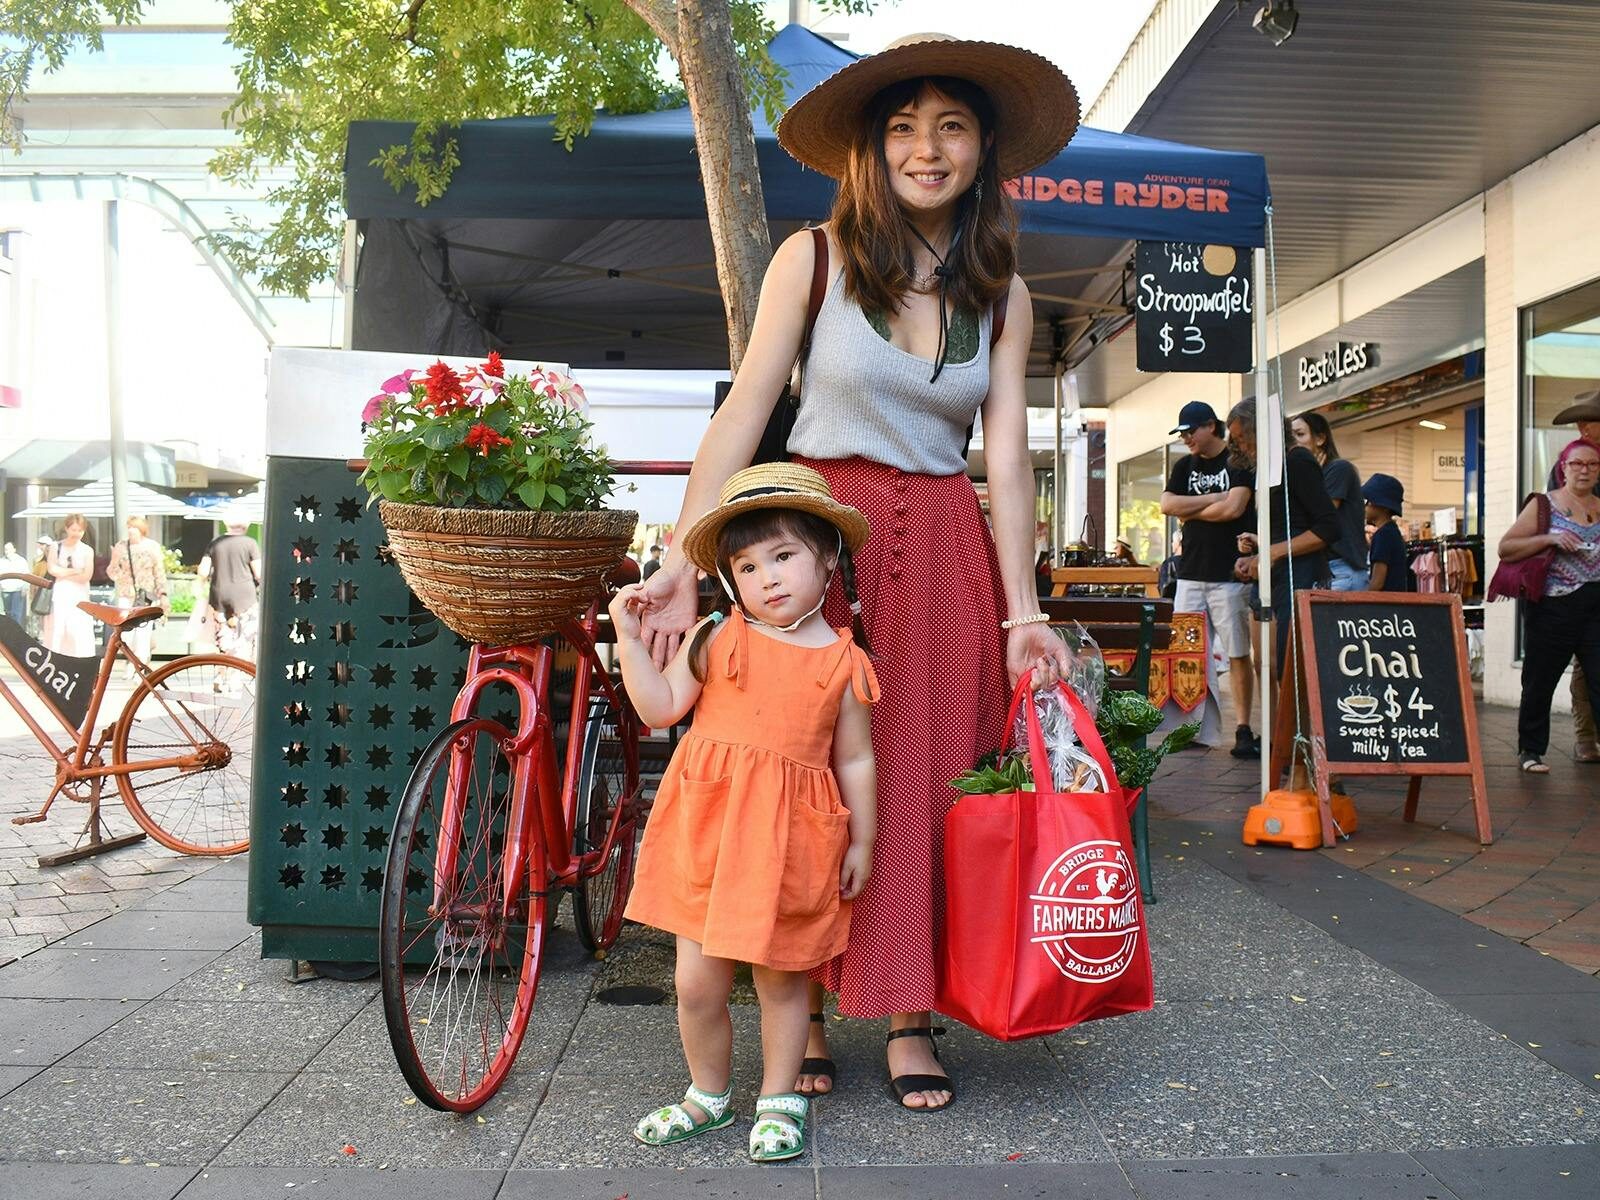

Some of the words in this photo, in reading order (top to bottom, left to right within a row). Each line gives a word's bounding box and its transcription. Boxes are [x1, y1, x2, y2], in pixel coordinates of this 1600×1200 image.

[1144, 174, 1204, 185] ADVENTURE
[1207, 178, 1231, 187] GEAR
[1114, 181, 1229, 213] RYDER
[1169, 252, 1199, 273] Hot
[1137, 274, 1252, 325] Stroopwafel
[1438, 455, 1466, 467] GIRLS
[1338, 613, 1416, 639] masala
[1338, 639, 1423, 679] Chai
[1339, 725, 1385, 739] sweet
[1390, 722, 1439, 743] spiced
[1352, 738, 1390, 762] milky
[1400, 742, 1427, 757] tea
[1058, 848, 1104, 877] BRIDGE
[1033, 904, 1105, 933] FARMERS
[1065, 956, 1125, 976] BALLARAT
